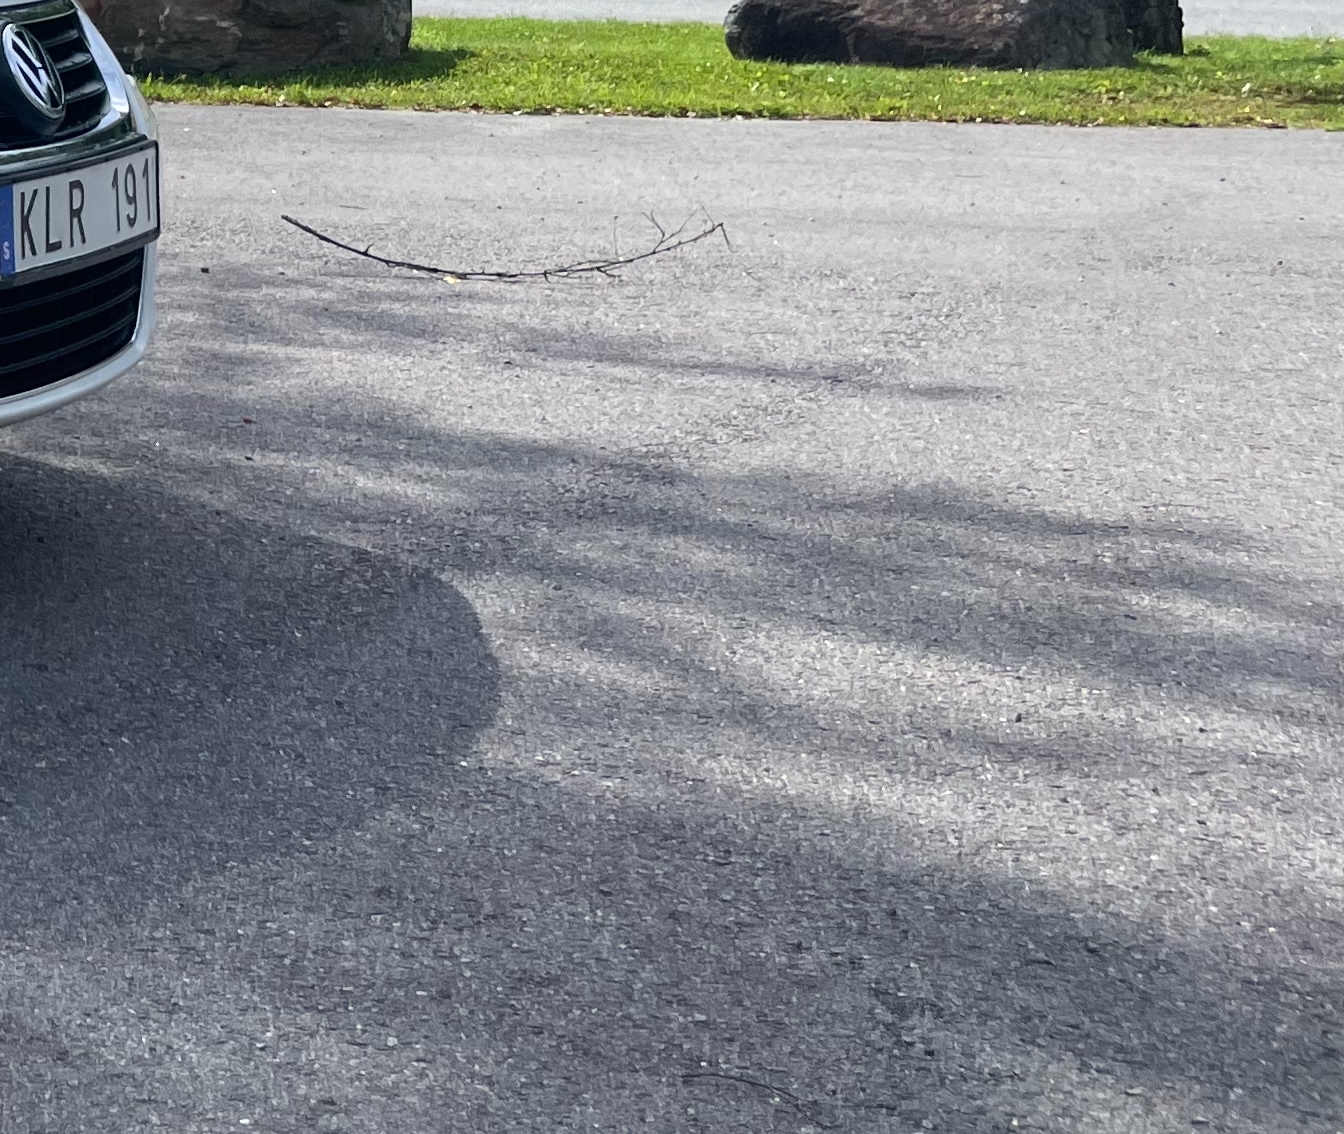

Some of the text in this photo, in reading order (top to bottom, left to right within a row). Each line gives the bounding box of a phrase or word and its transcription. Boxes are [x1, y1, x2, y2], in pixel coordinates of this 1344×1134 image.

[19, 158, 152, 260] KLR 191
[3, 241, 10, 260] S
